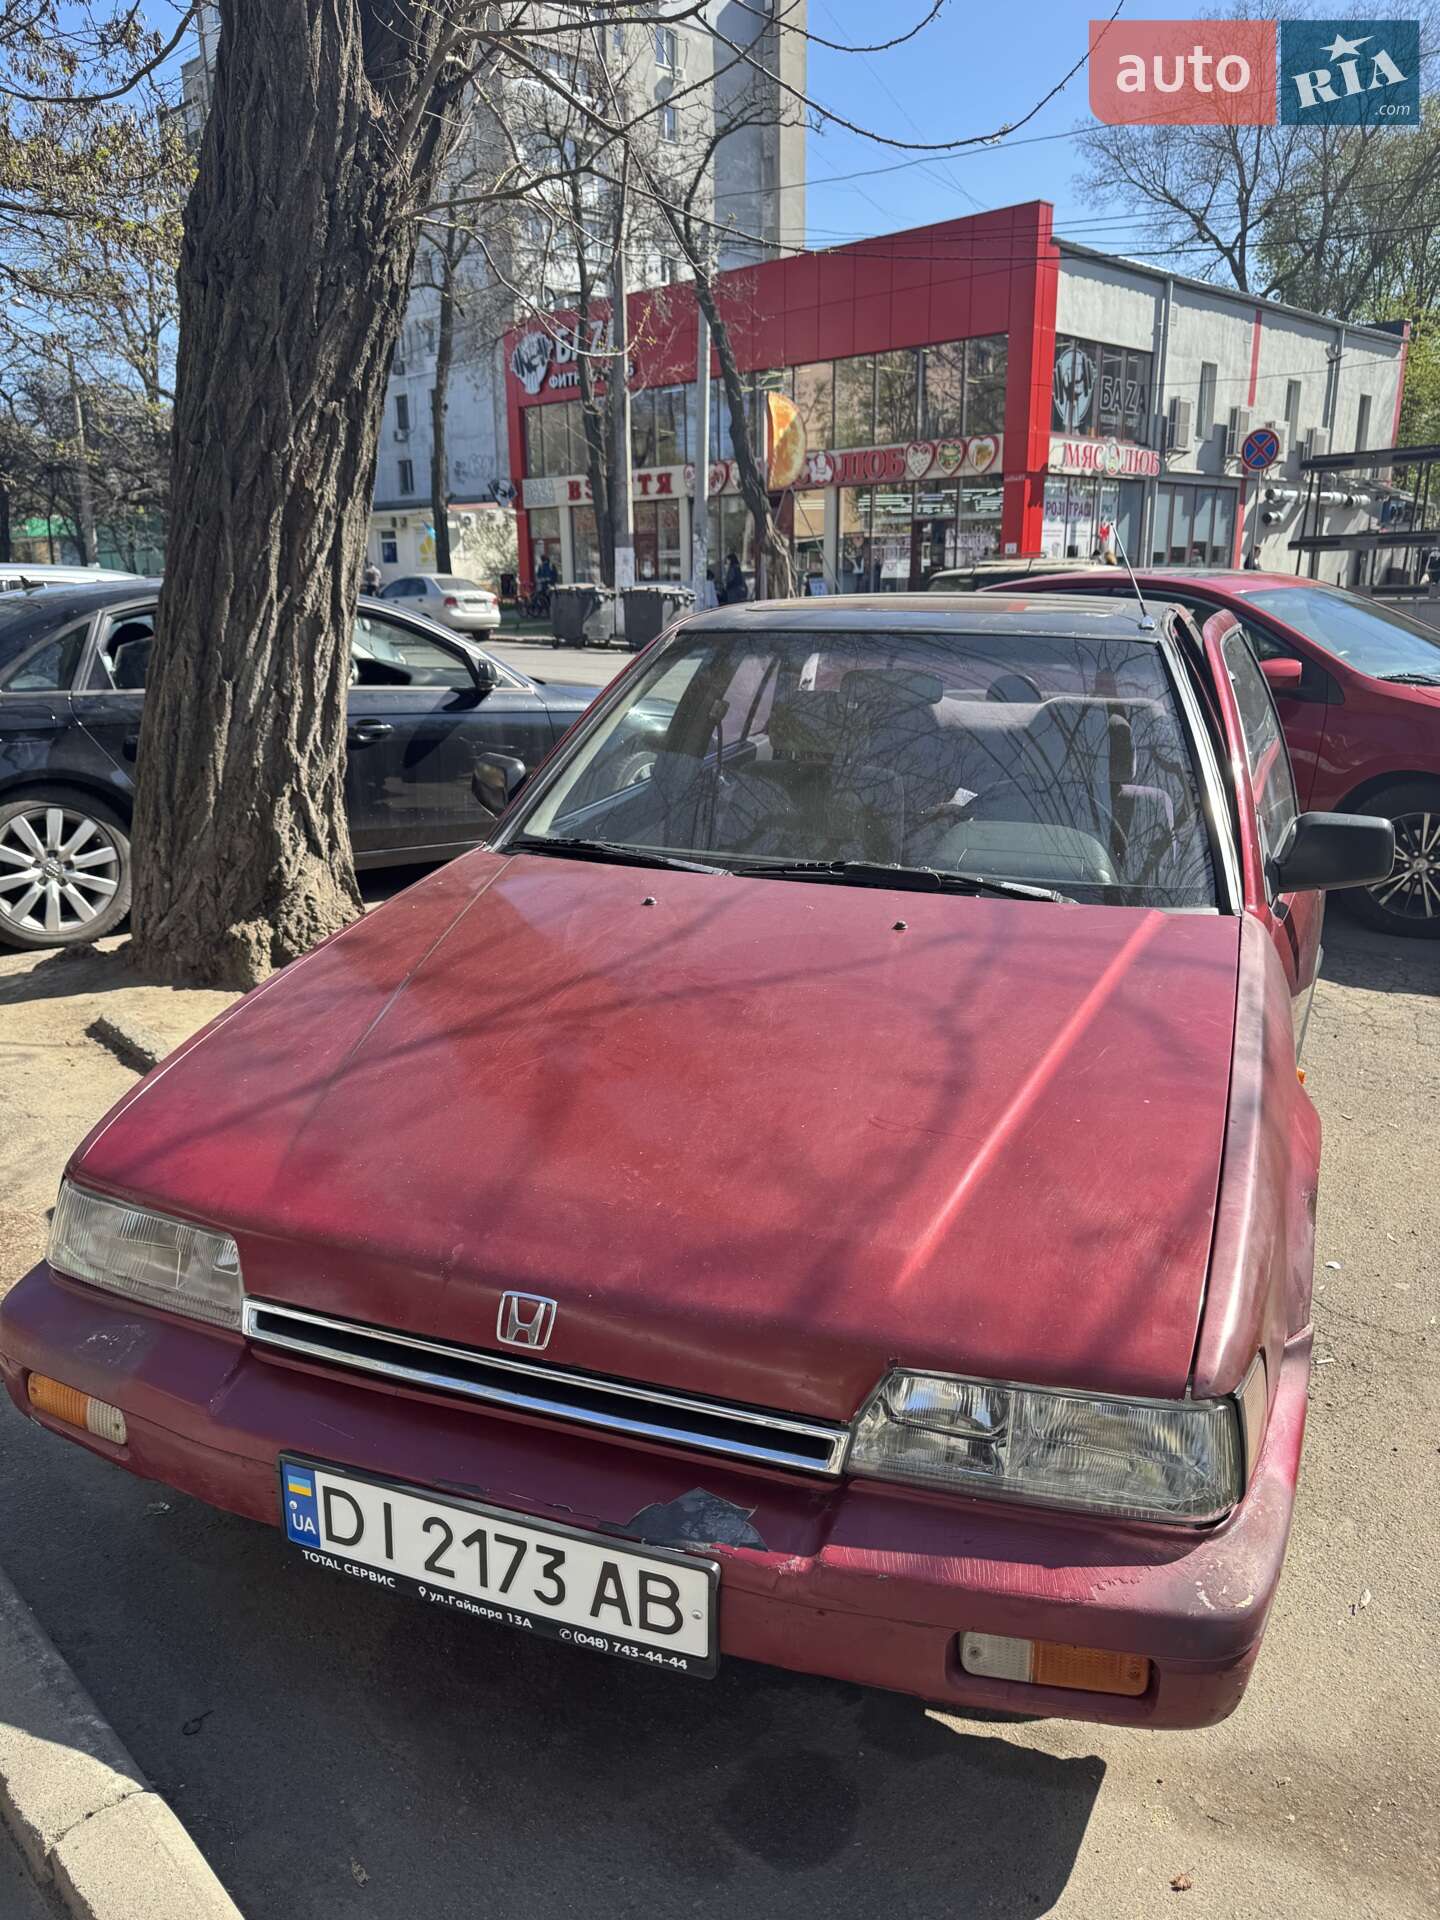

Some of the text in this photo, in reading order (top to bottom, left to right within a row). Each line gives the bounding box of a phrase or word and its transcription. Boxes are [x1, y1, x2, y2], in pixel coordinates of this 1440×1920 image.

[292, 1513, 317, 1536] UA
[302, 1549, 396, 1588] TOTAL СЕРВИС
[322, 1485, 684, 1635] DI 2173 AB
[507, 1612, 533, 1629] 13А
[573, 1631, 688, 1670] (048) 743-44-44
